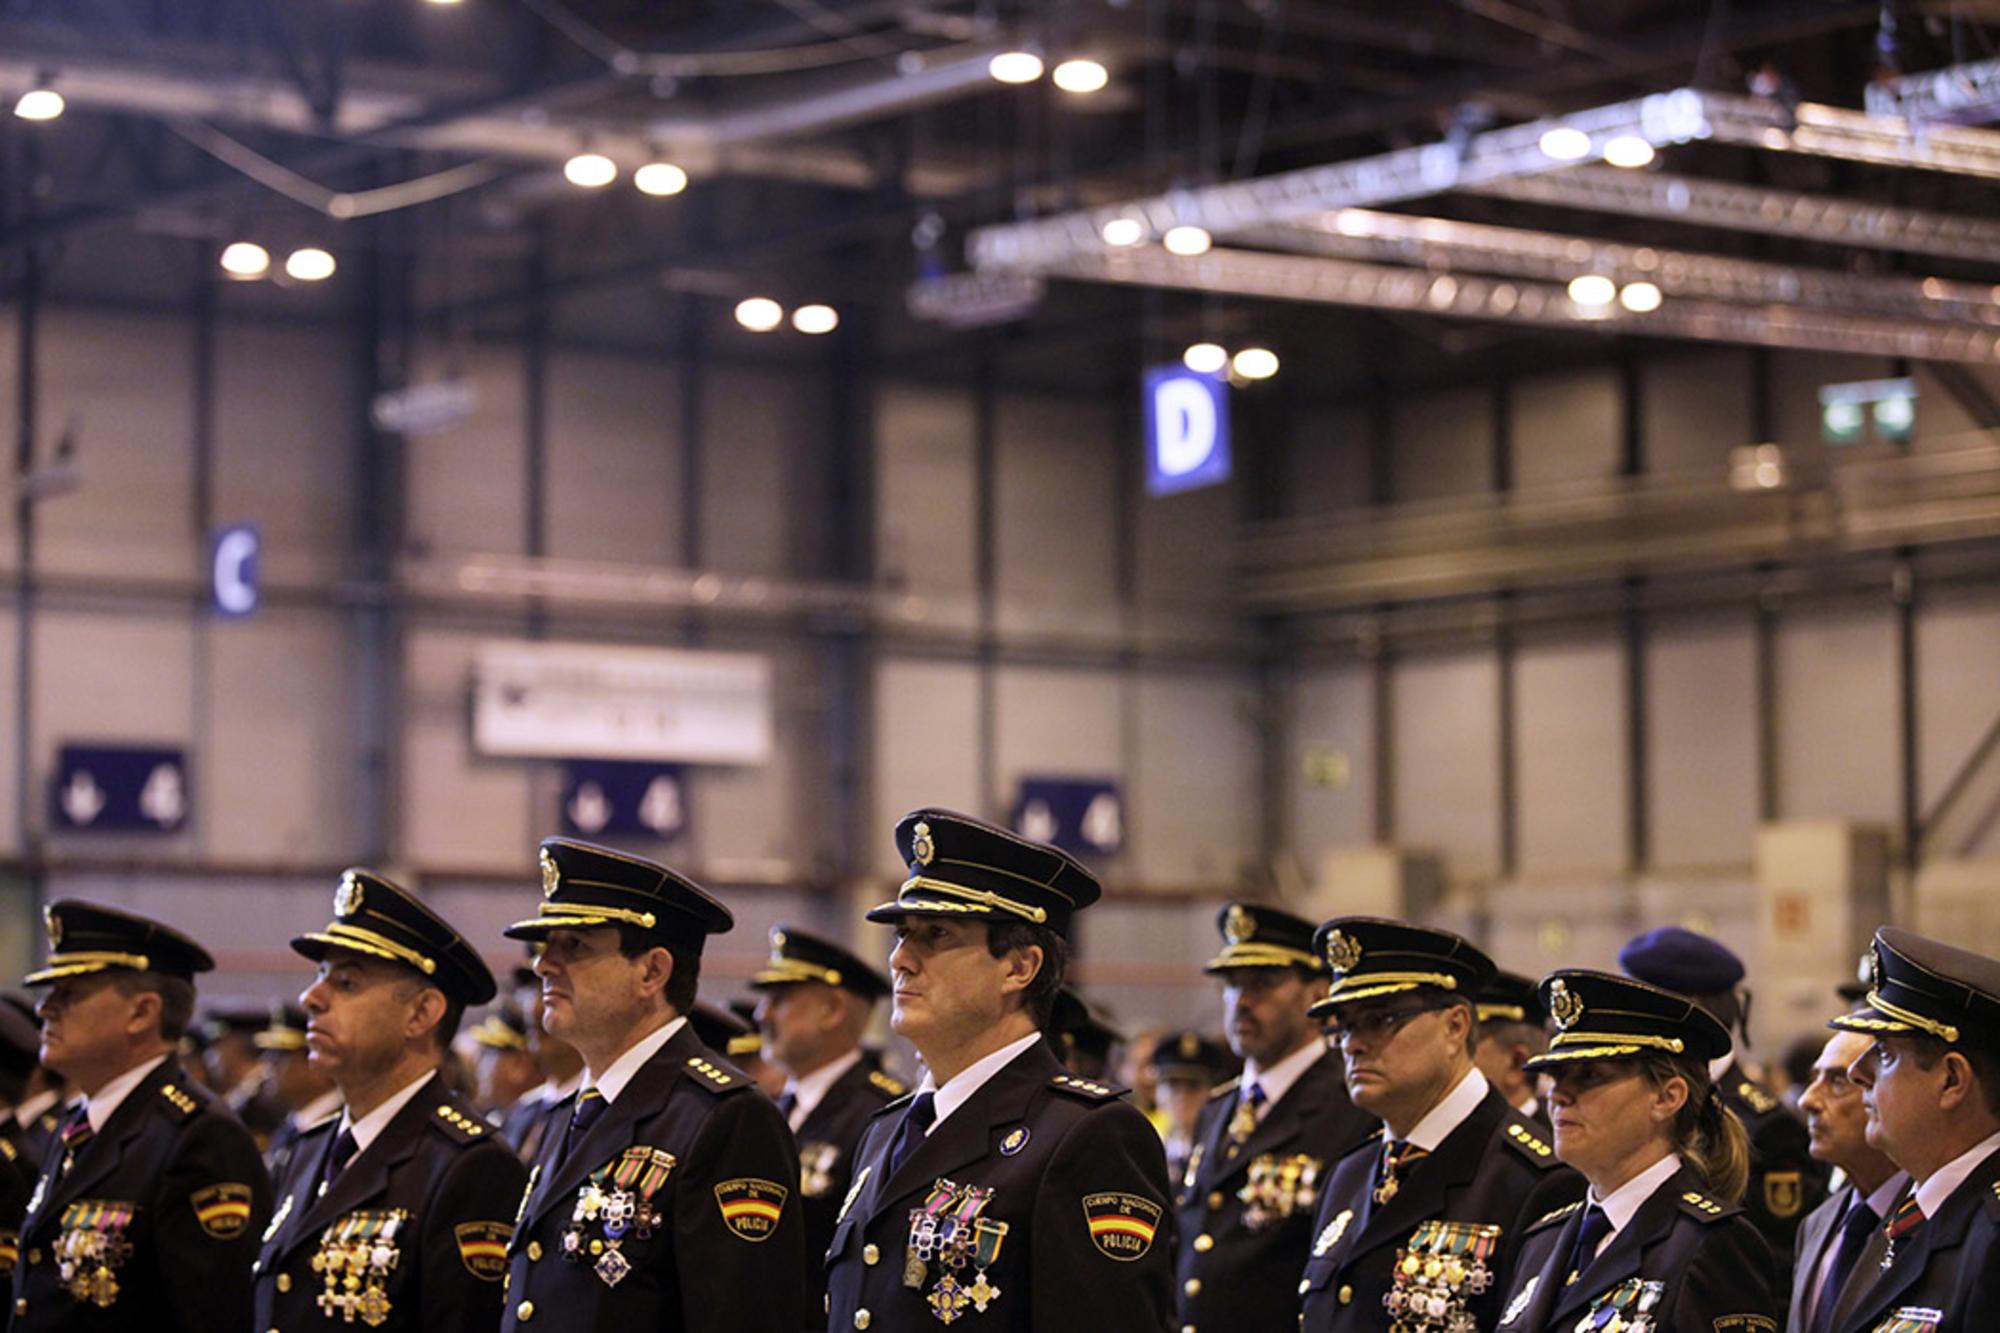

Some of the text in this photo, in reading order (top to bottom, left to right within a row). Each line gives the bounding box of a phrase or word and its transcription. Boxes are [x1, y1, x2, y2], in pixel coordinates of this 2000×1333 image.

[1155, 378, 1216, 476] D
[214, 530, 256, 613] C
[1086, 1196, 1159, 1216] CUERPO NACIONAL
[1120, 1205, 1131, 1214] DE
[1103, 1234, 1141, 1252] POLICIA
